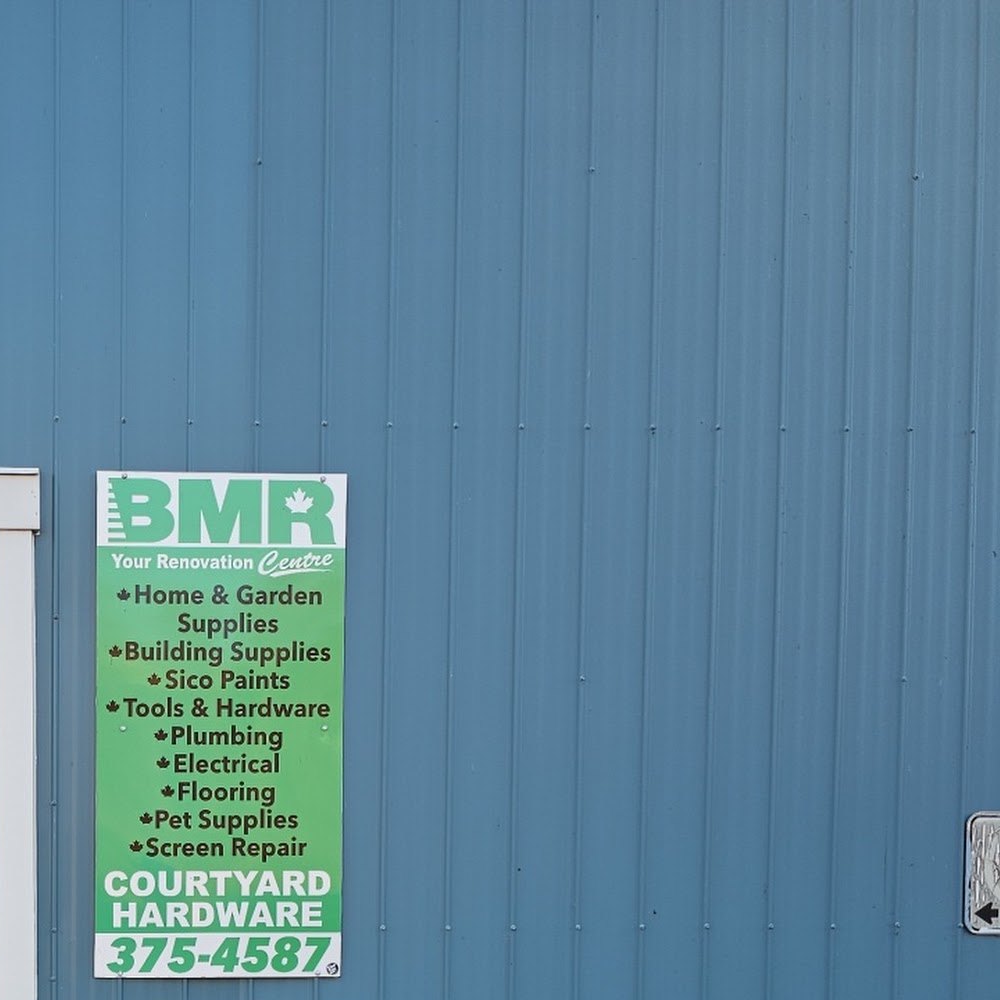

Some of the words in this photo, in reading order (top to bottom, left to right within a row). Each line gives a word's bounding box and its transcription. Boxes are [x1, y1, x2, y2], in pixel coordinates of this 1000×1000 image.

[108, 478, 336, 545] BMR
[111, 554, 152, 569] Your
[157, 554, 254, 570] Renovation
[257, 550, 334, 577] Centre
[134, 584, 204, 605] Home
[211, 585, 229, 605] &
[236, 584, 323, 606] Garden
[177, 612, 279, 639] Supplies
[125, 640, 223, 667] Building
[230, 641, 331, 667] Supplies
[165, 669, 213, 690] Sico
[221, 669, 290, 690] Paints
[123, 697, 184, 718] Tools
[191, 698, 209, 718] &
[217, 697, 331, 718] Hardware
[171, 726, 283, 751] Plumbing
[174, 753, 280, 774] Electrical
[177, 781, 275, 807] Flooring
[155, 810, 192, 829] Pet
[198, 809, 299, 835] Supplies
[146, 837, 224, 858] Screen
[232, 837, 307, 863] Repair
[104, 870, 331, 897] COURTYARD
[112, 901, 323, 928] HARDWARE
[106, 936, 332, 974] 375-4587
